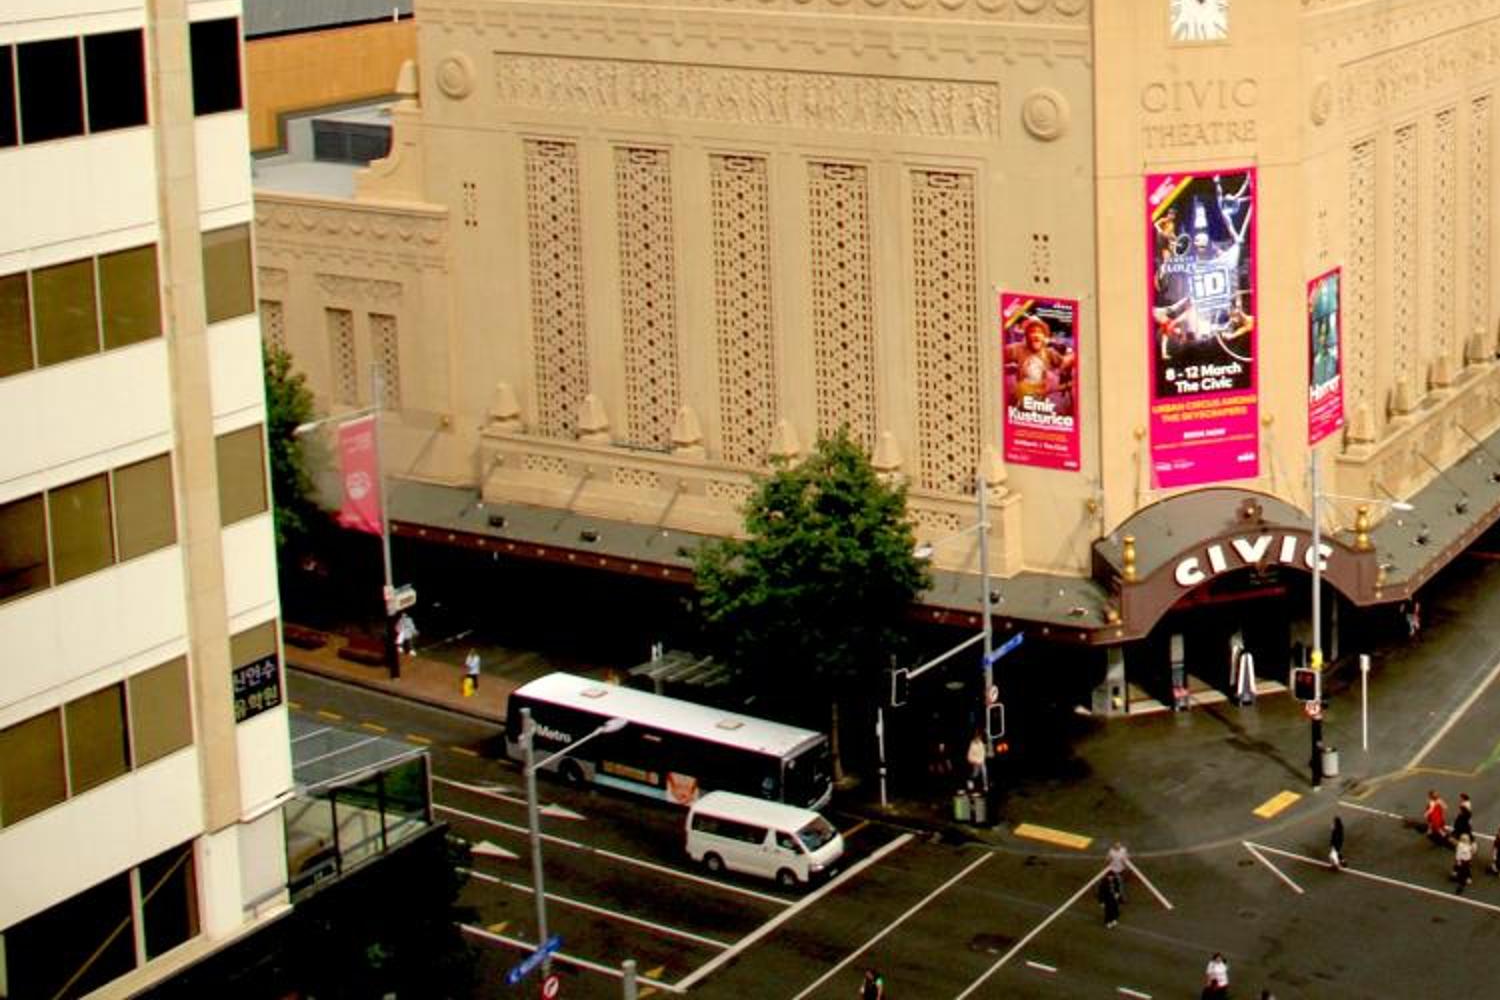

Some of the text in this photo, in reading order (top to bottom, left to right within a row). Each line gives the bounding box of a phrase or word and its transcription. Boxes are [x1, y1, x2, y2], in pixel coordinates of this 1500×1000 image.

[1140, 77, 1258, 114] CIVIC
[1141, 119, 1257, 149] THEATRE
[1165, 368, 1176, 381] 8
[1185, 365, 1199, 379] 12
[1201, 361, 1242, 377] March
[1174, 376, 1233, 393] The Civic
[1023, 395, 1056, 412] Emir
[1008, 405, 1074, 427] Kusturica
[1175, 535, 1334, 586] CIVIC
[536, 723, 572, 744] Metro
